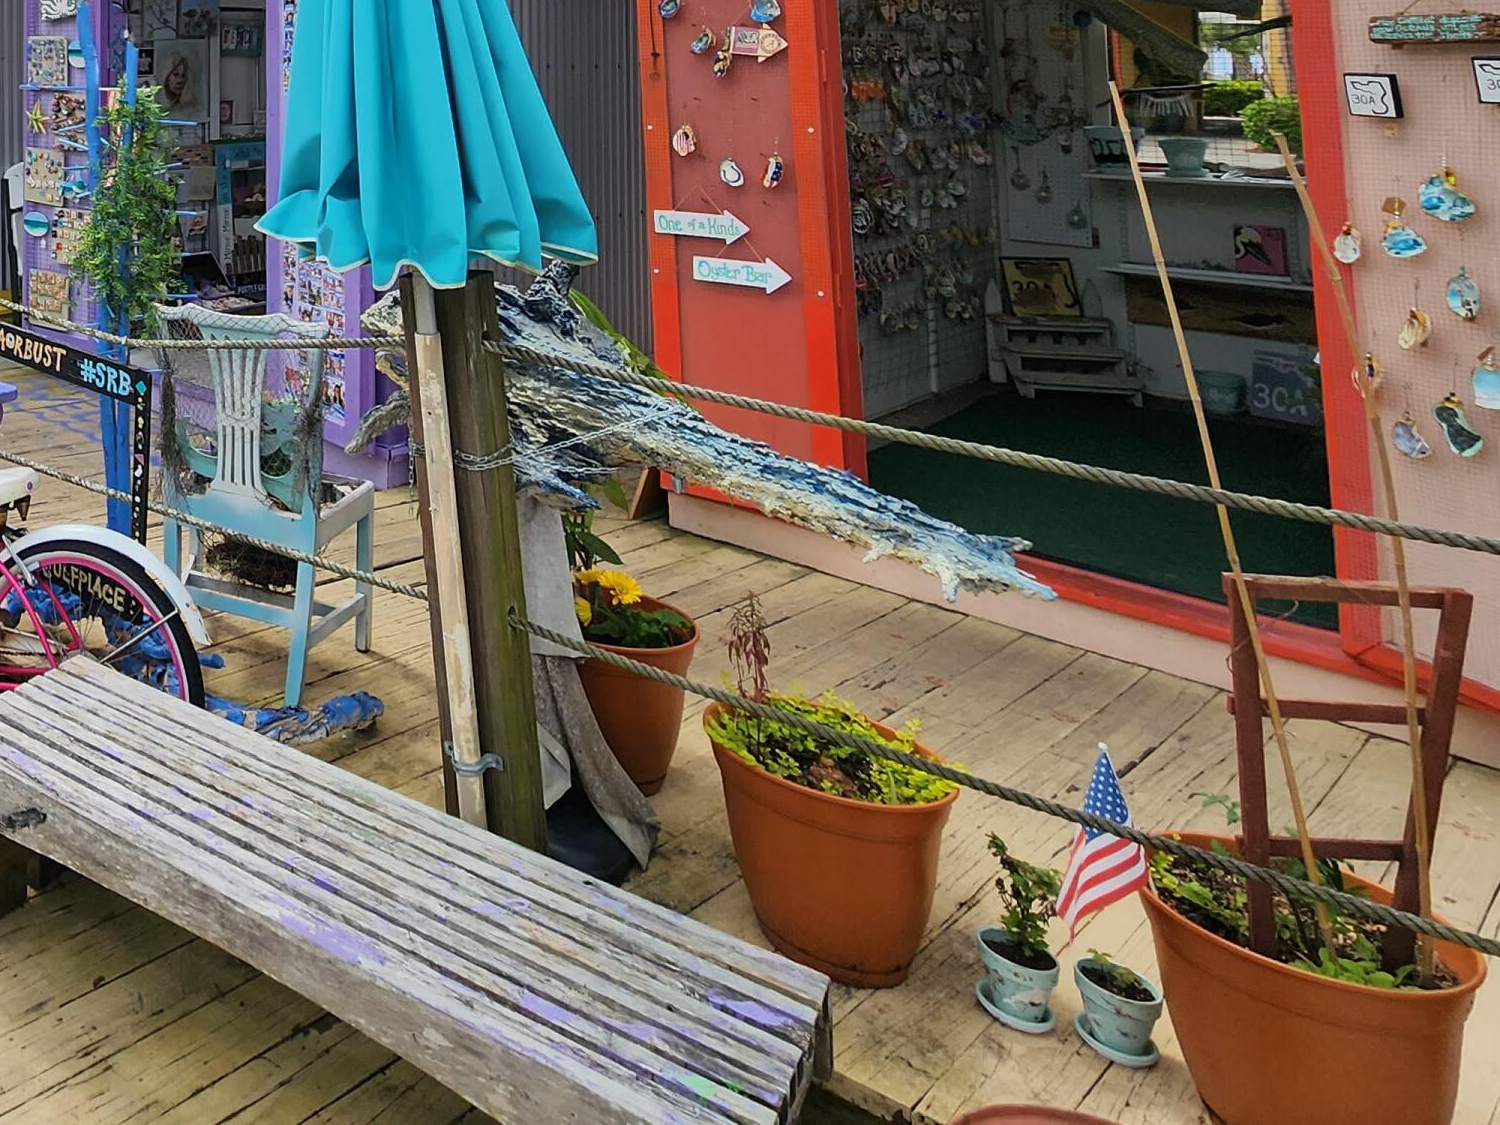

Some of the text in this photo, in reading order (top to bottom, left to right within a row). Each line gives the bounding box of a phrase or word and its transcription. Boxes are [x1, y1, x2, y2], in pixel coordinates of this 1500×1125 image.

[1351, 93, 1377, 106] 30A
[658, 215, 683, 232] One
[707, 217, 741, 237] Kinds
[698, 259, 772, 284] Oyster Bar
[79, 357, 132, 397] #SRB
[1253, 383, 1308, 417] 30A
